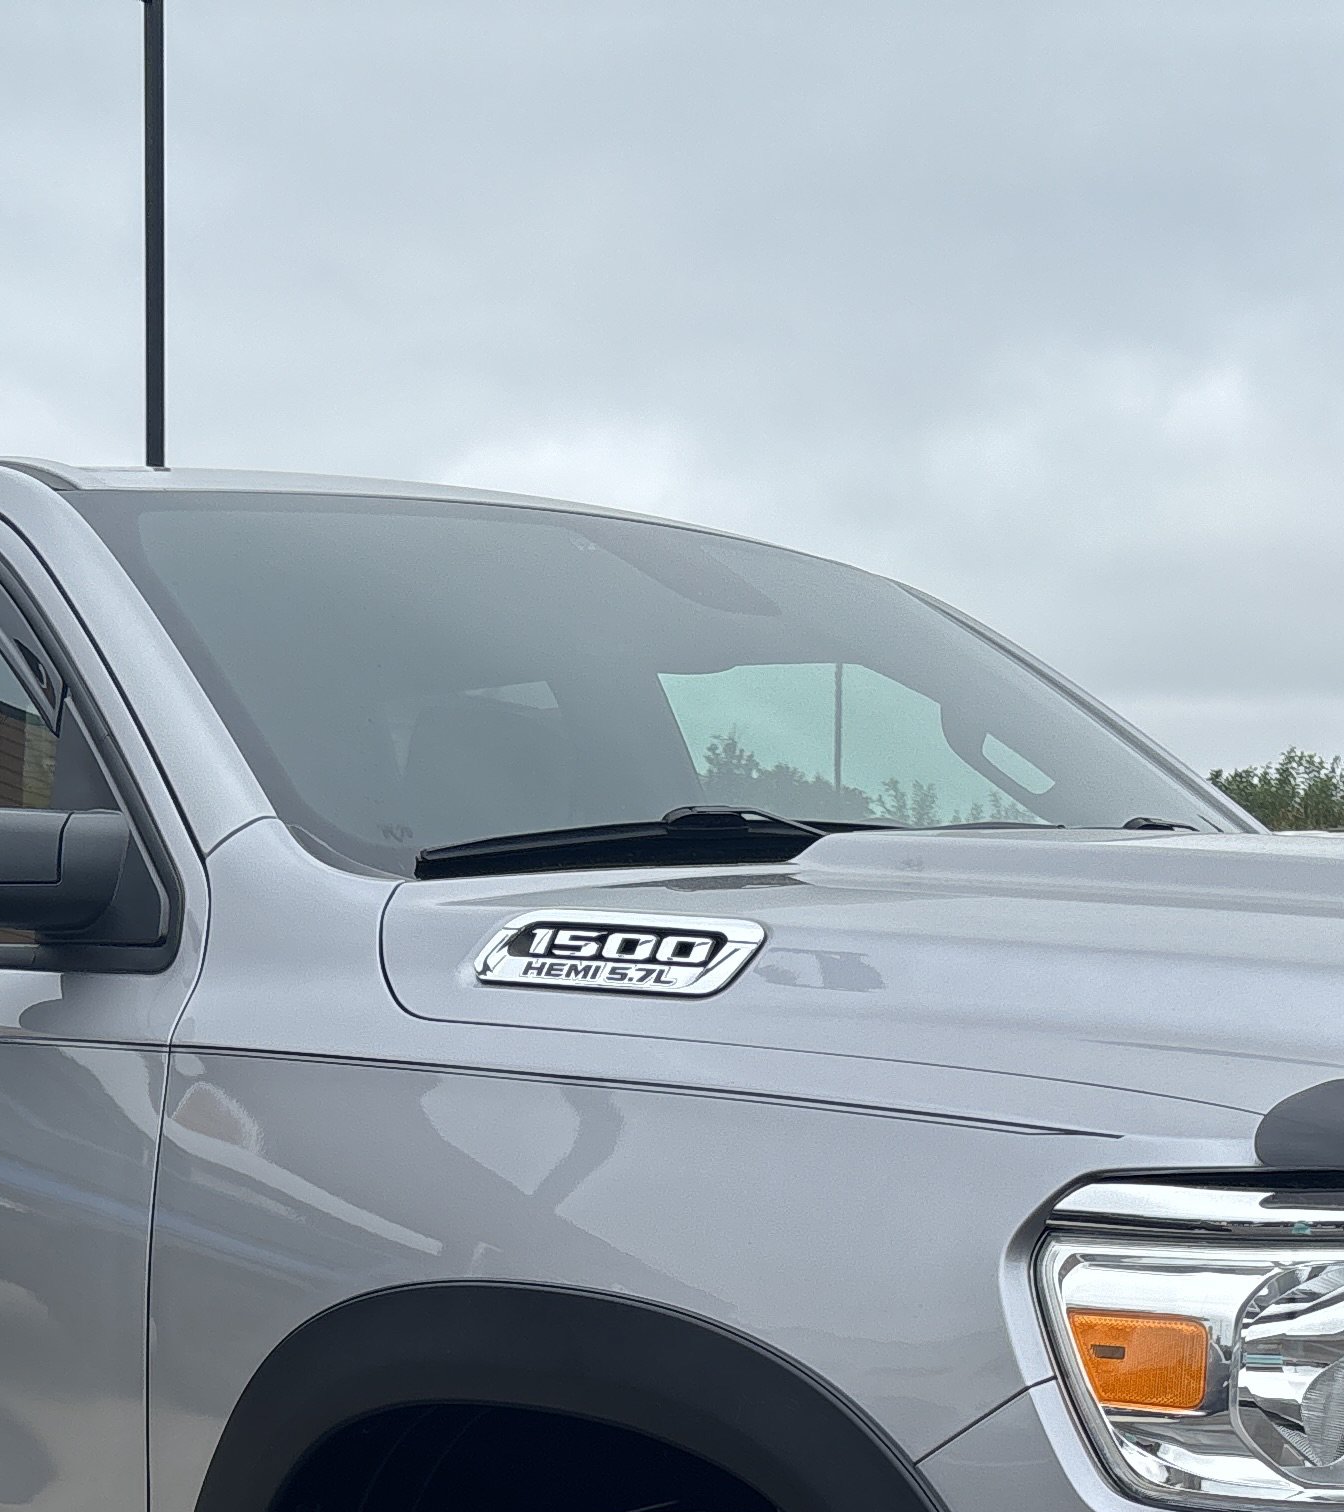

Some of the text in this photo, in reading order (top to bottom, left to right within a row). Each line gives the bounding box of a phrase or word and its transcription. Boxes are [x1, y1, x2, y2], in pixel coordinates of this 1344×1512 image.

[530, 927, 712, 964] 1500
[521, 960, 674, 985] HEMI 5.7L
